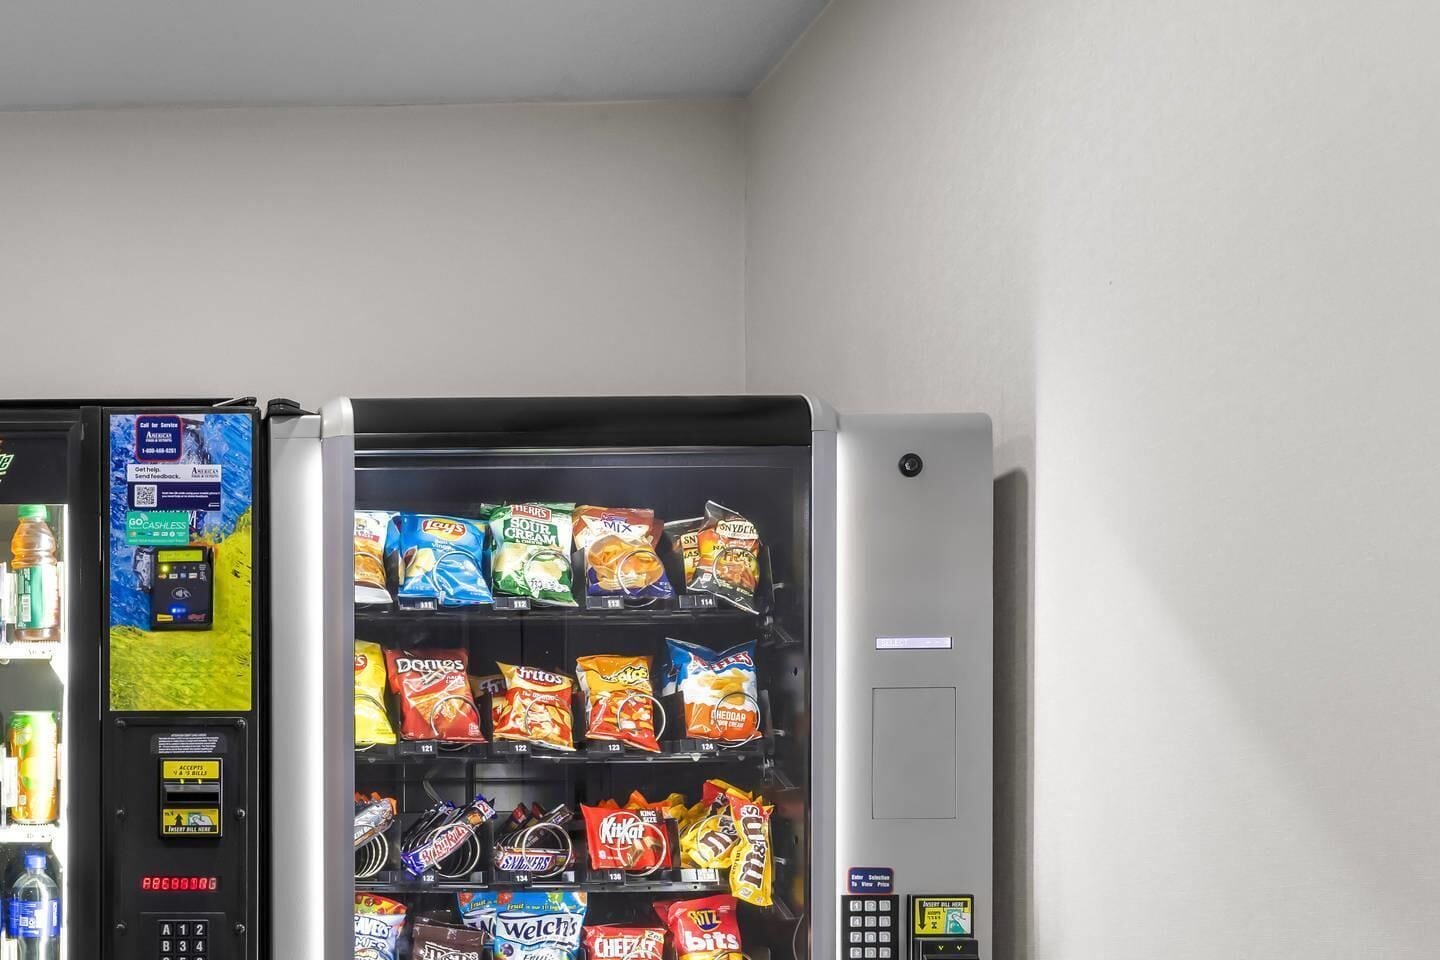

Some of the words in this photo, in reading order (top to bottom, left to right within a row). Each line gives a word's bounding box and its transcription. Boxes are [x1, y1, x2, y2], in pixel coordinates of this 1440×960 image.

[129, 518, 143, 526] GO
[142, 521, 187, 529] CASHLESS
[511, 519, 550, 535] SOUR
[603, 521, 632, 533] MIX
[504, 527, 557, 545] CREAM
[168, 825, 186, 833] INSERT
[688, 910, 722, 926] RITZ
[162, 924, 171, 936] A
[179, 924, 186, 936] 1
[196, 924, 204, 936] 2
[502, 916, 577, 940] Welch's
[162, 940, 170, 952] B
[179, 940, 187, 952] 3
[196, 940, 203, 952] 4
[684, 931, 739, 951] bits
